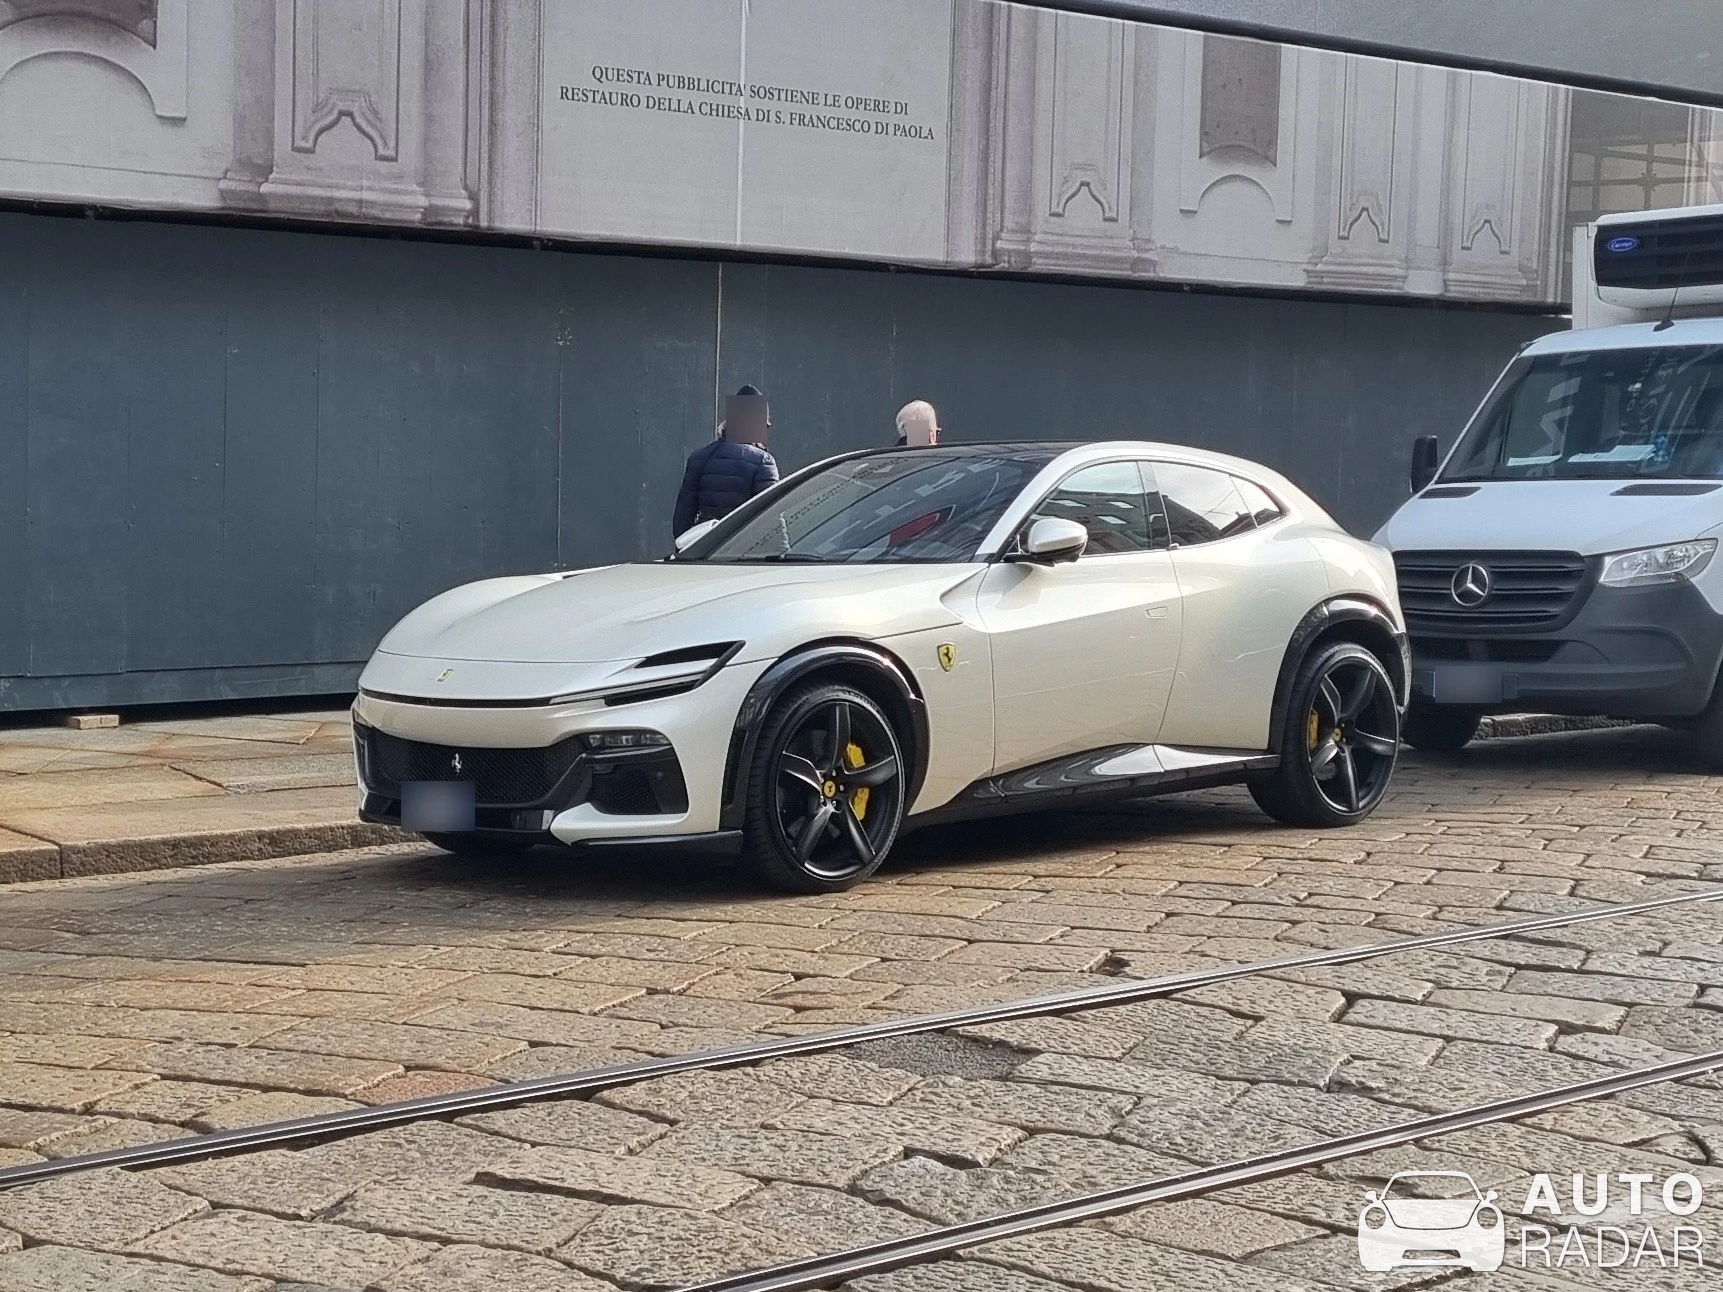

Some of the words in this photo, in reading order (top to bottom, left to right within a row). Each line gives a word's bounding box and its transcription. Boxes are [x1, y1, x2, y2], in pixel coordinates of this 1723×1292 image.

[560, 85, 641, 108] RESTAURO
[645, 95, 695, 115] DELLA
[698, 101, 752, 121] CHIESA
[755, 108, 771, 123] DI
[774, 110, 786, 125] S.
[789, 111, 871, 133] FRANCESCO
[874, 121, 890, 135] DI
[893, 123, 935, 140] PAOLA
[591, 65, 653, 86] QUESTA
[656, 73, 746, 97] PUBBLICITA'
[749, 84, 820, 106] SOSTIENE
[823, 93, 841, 108] LE
[844, 95, 891, 113] OPERE
[893, 101, 909, 115] DI
